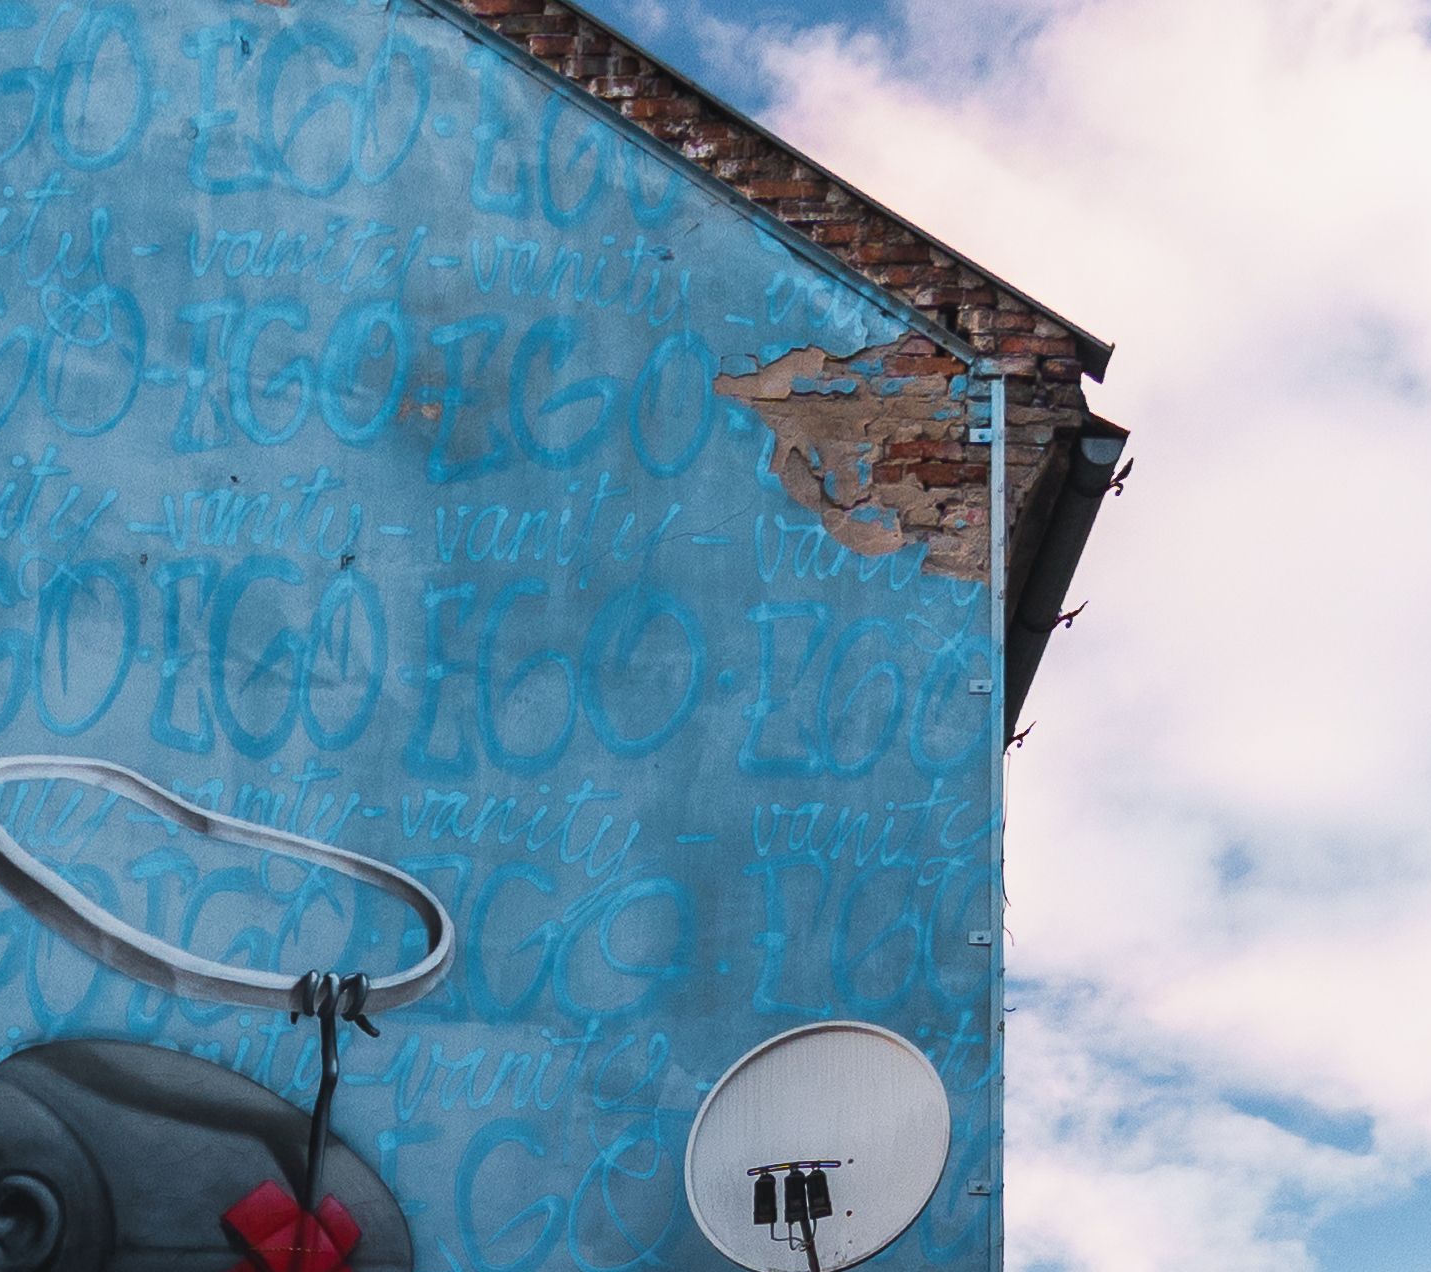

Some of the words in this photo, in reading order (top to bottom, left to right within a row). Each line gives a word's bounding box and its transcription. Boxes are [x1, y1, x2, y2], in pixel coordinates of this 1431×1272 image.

[180, 20, 431, 199] EGO
[189, 214, 428, 298] vanity
[470, 228, 694, 330] vanity
[171, 296, 409, 454] EGO
[426, 310, 717, 486] EGO
[157, 463, 363, 562] vanity
[434, 470, 684, 590] vanity
[147, 552, 390, 760] EGO
[402, 578, 709, 779] EGO
[398, 780, 640, 880] vanity
[751, 778, 1001, 868] vanity
